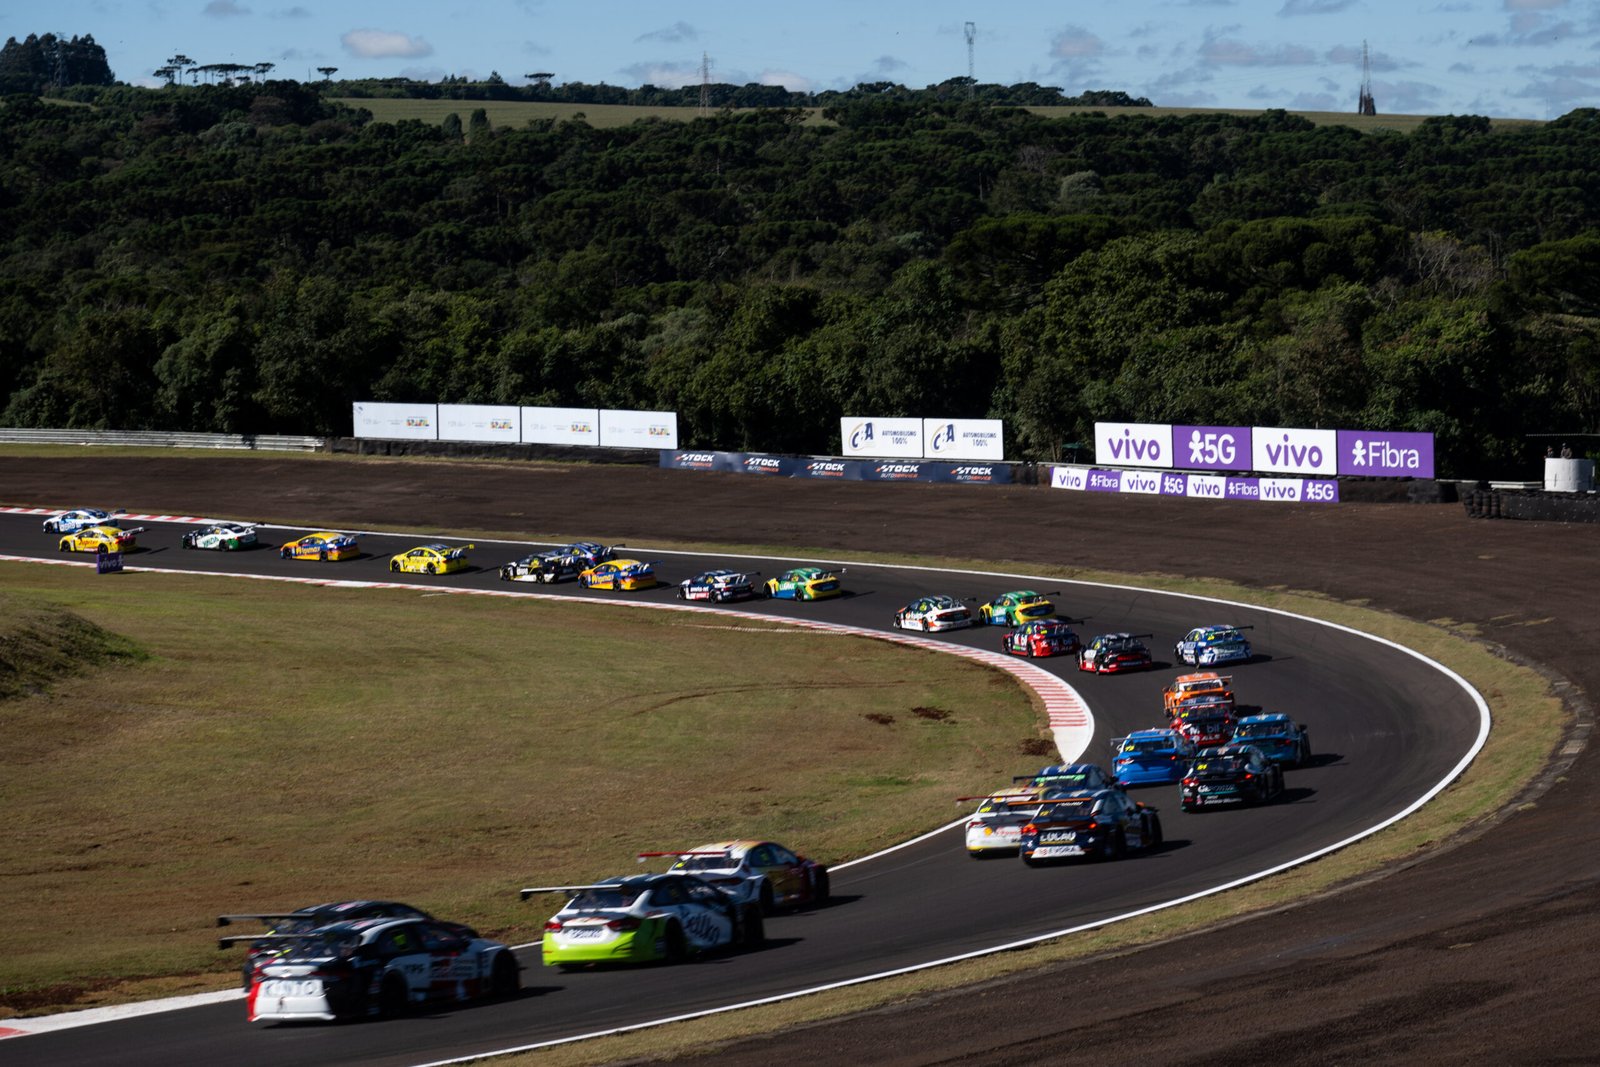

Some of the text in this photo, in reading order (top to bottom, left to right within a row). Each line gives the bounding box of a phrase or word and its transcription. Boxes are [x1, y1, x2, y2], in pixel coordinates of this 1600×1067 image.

[891, 437, 908, 445] 100%
[972, 439, 988, 447] 100%
[1108, 428, 1161, 461] vivo
[1204, 433, 1236, 465] 5G
[1265, 433, 1323, 468] vivo
[680, 453, 715, 462] STOCK
[1368, 441, 1419, 469] Fibra
[747, 457, 780, 466] STOCK
[812, 462, 845, 471] STOCK
[880, 464, 920, 473] STOCK
[956, 467, 992, 475] STOCK
[1059, 470, 1334, 500] vivo Fibra vivo 5G vivo Fibra vivo 5G
[100, 557, 116, 569] vivo
